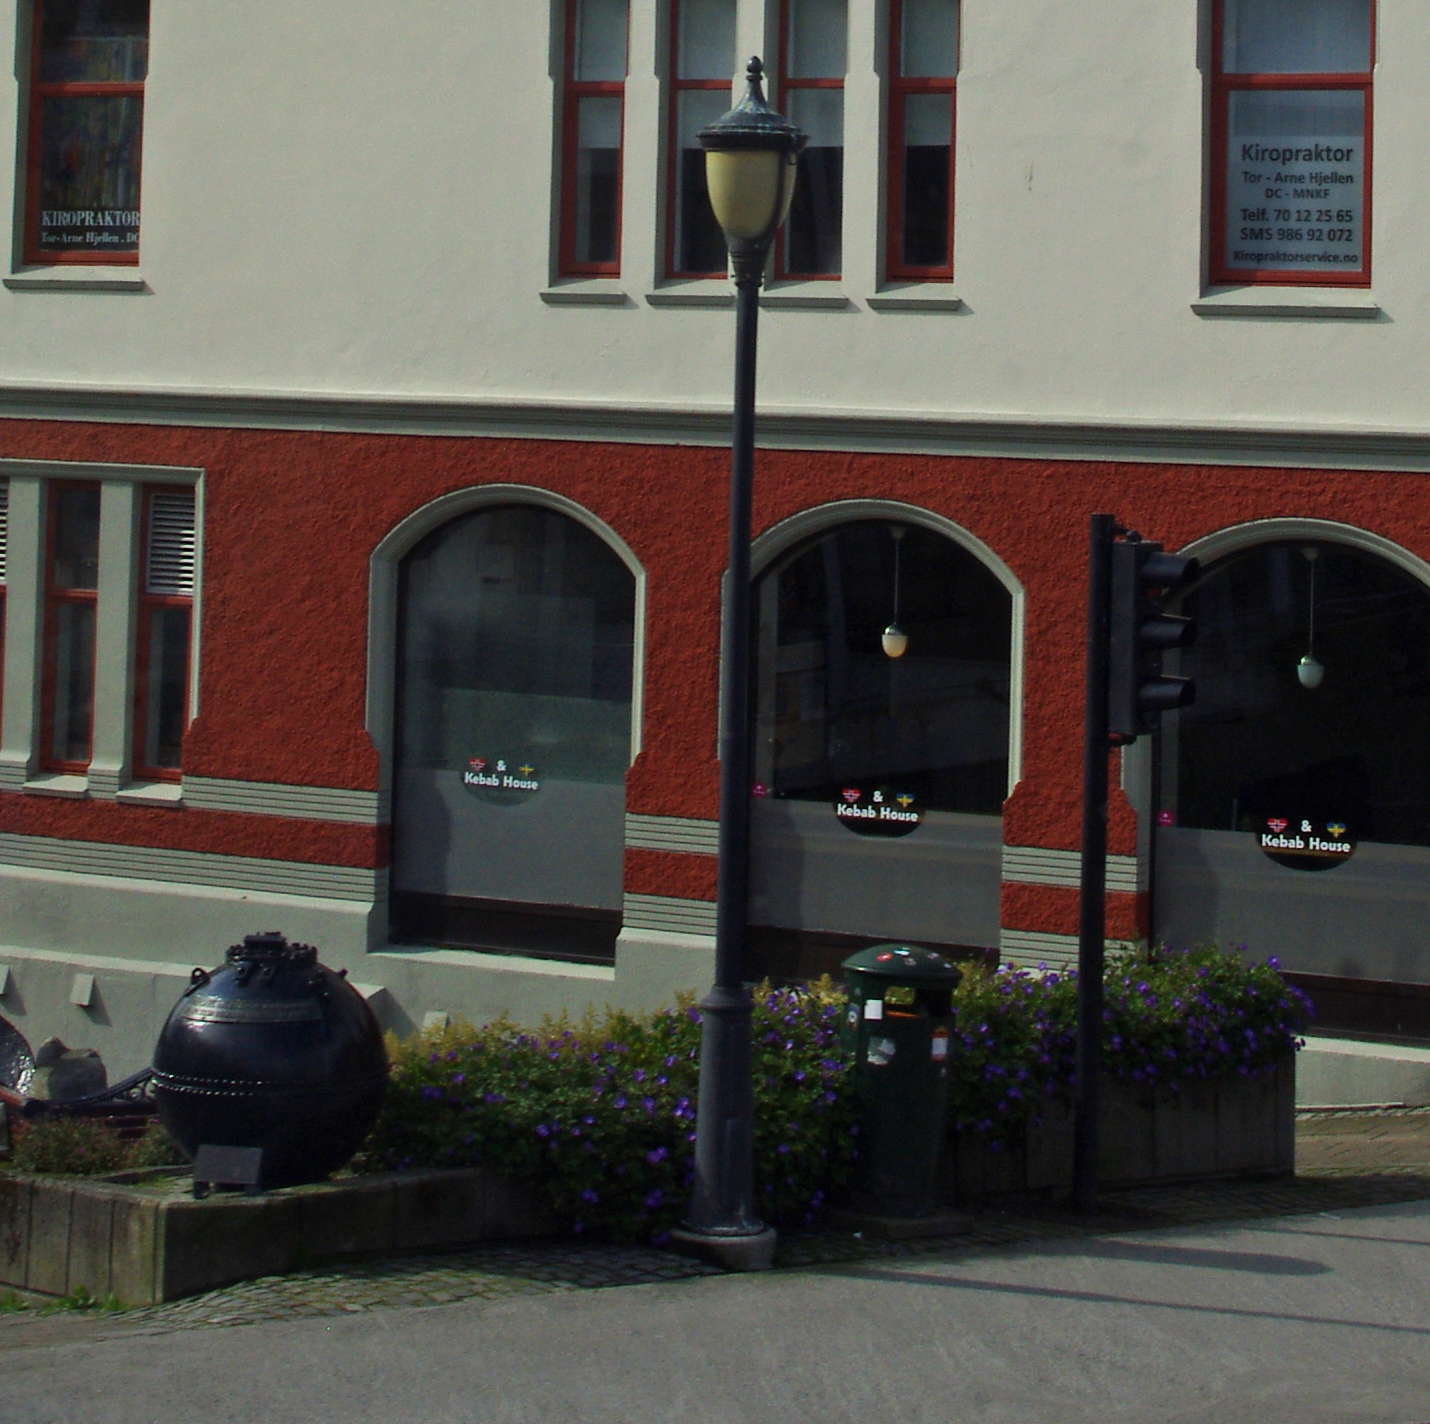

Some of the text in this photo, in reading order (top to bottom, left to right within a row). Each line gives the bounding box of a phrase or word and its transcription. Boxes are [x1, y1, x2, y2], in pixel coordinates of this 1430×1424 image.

[1241, 143, 1354, 165] Kiropraktor
[1242, 171, 1263, 184] Tor
[1274, 172, 1306, 184] Arne
[1309, 172, 1354, 186] Hjellen
[1265, 188, 1282, 199] DC
[1293, 188, 1330, 199] MNKF
[41, 210, 140, 226] KIROPRAKTOR
[1240, 207, 1353, 223] Telf. 70 12 25 65
[41, 232, 83, 243] Tor-Arne
[85, 231, 120, 246] Hjellen
[1240, 227, 1353, 242] SMS 986 92 072
[1233, 250, 1358, 263] Kiropraktorservice.no
[496, 759, 507, 772] &
[464, 771, 539, 790] Kebab House
[873, 790, 884, 803] &
[837, 803, 919, 822] Kebab House
[1300, 819, 1312, 833] &
[1261, 833, 1351, 853] Kebab House
